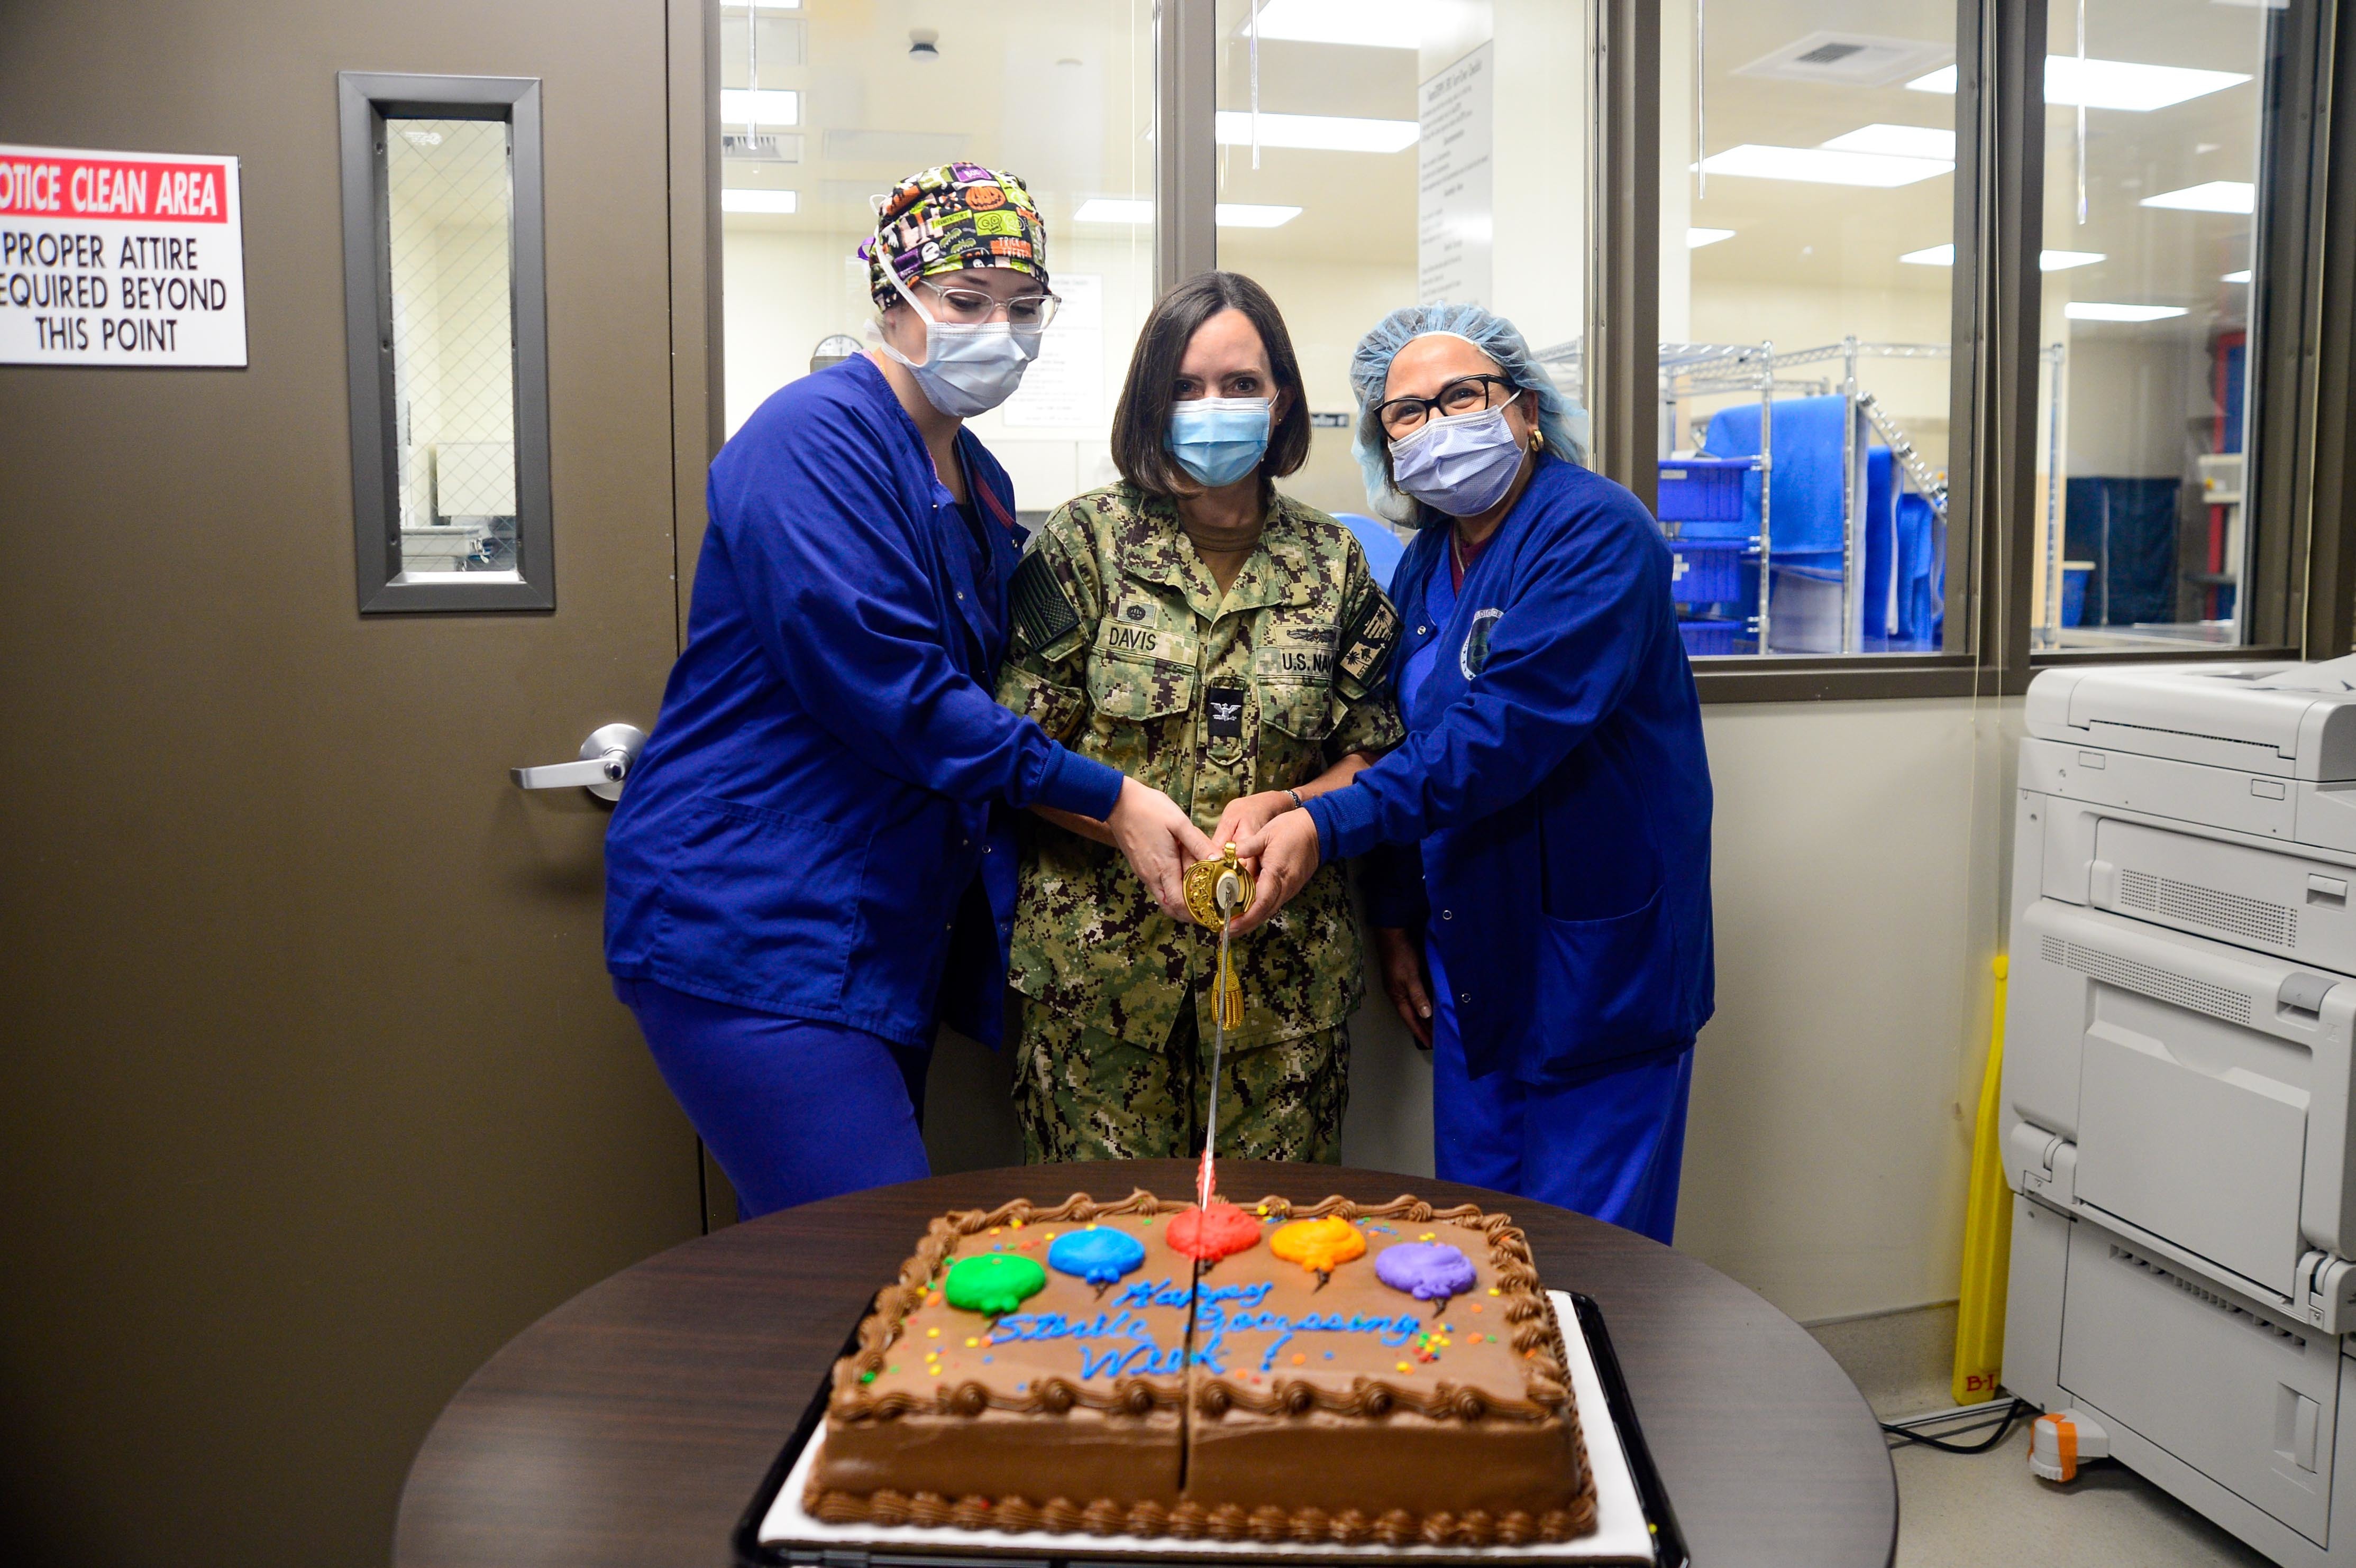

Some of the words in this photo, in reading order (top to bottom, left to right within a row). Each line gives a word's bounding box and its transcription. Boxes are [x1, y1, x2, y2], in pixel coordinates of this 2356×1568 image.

[0, 162, 61, 210] OTICE
[70, 166, 147, 214] CLEAN
[154, 171, 218, 216] AREA
[3, 231, 106, 269] PROPER
[120, 236, 198, 270] ATTIRE
[997, 236, 1020, 248] TRICK
[0, 272, 109, 309] EQUIRED
[122, 277, 227, 311] BEYOND
[35, 317, 89, 351] THIS
[102, 318, 178, 352] POINT
[1109, 627, 1157, 651] DAVIS
[1282, 653, 1310, 671] U.S.
[1313, 654, 1334, 673] NAV
